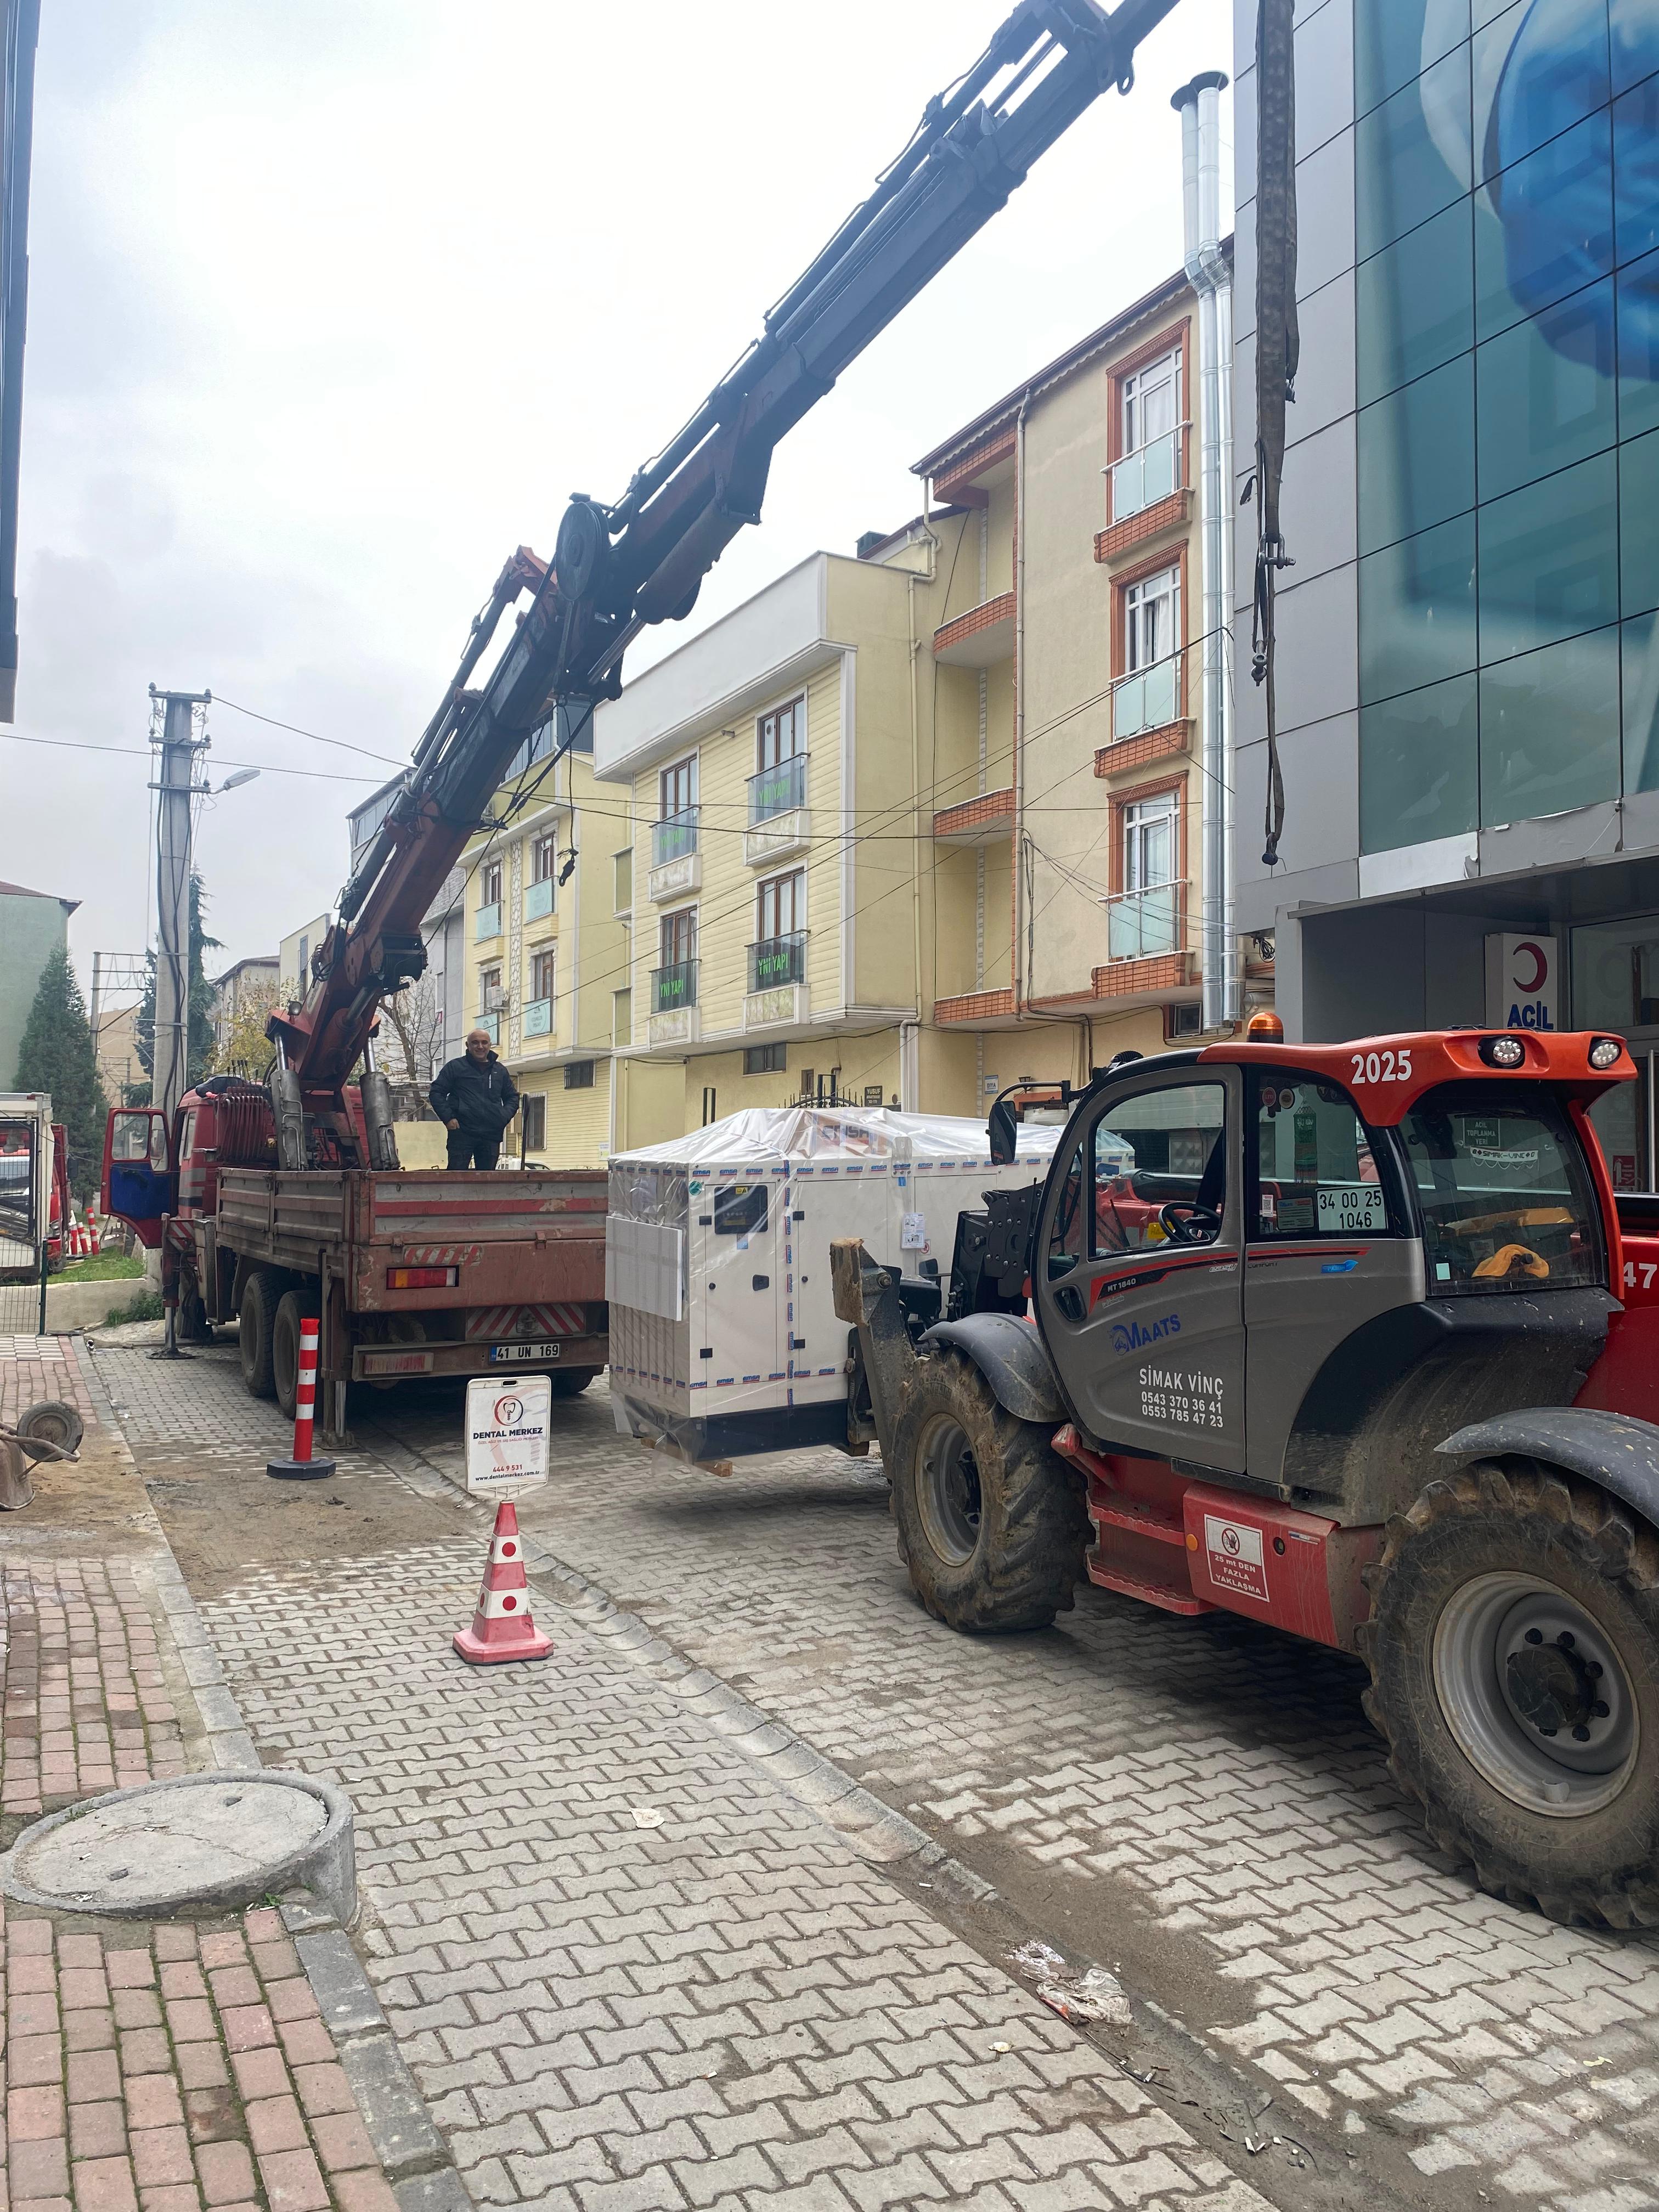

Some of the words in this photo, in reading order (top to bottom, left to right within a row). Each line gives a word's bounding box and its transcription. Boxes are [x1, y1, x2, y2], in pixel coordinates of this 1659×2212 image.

[772, 953, 788, 972] YAPI
[671, 979, 683, 995] YAPI
[1351, 1049, 1412, 1084] 2025
[1320, 1194, 1335, 1210] 34
[1342, 1192, 1358, 1208] 00
[1365, 1190, 1381, 1207] 25
[1340, 1212, 1372, 1228] 1046
[1209, 1263, 1238, 1272] easy
[1118, 1278, 1136, 1289] 1840
[1113, 1314, 1181, 1352] MAATS
[498, 1347, 509, 1359] 41
[518, 1346, 531, 1358] UN
[540, 1345, 558, 1357] 169
[1139, 1365, 1183, 1390] SİMAK
[1188, 1371, 1223, 1400] VİNÇ
[1141, 1391, 1166, 1406] 0543
[1170, 1395, 1188, 1409] 370
[1192, 1398, 1205, 1411] 36
[1209, 1401, 1221, 1414] 41
[1142, 1404, 1166, 1419] 0553
[1170, 1408, 1189, 1422] 785
[1193, 1412, 1205, 1425] 47
[1210, 1415, 1223, 1427] 23
[473, 1430, 506, 1440] DENTAL
[509, 1427, 543, 1436] MERKEZ
[476, 1471, 540, 1481] www.dentalmerkez.com.tr
[1215, 1554, 1224, 1562] 25
[1238, 1562, 1256, 1573] DEN
[1223, 1567, 1250, 1581] FAZLA
[1215, 1573, 1261, 1595] YAKLAŞMA
